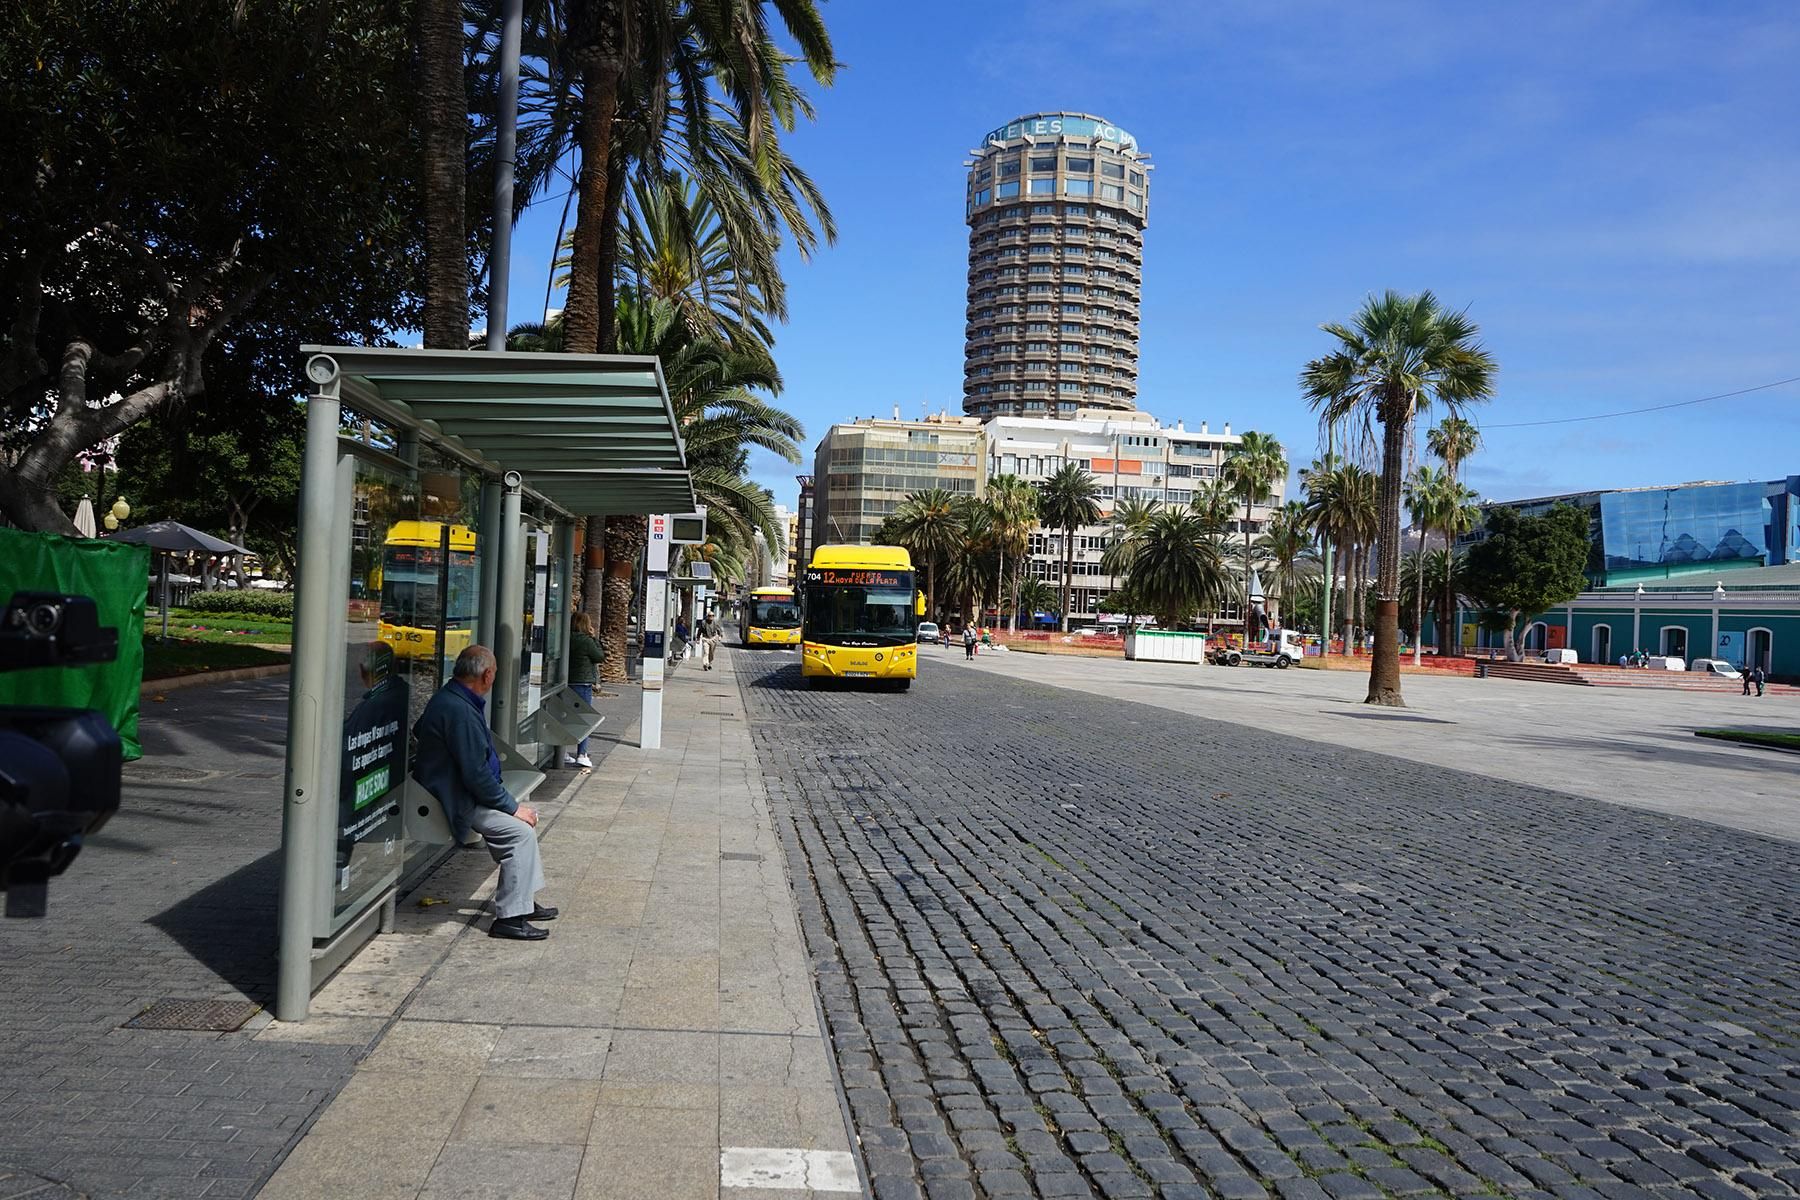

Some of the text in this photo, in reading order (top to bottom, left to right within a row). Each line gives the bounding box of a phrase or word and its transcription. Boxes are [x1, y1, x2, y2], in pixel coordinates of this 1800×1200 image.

[1094, 125, 1115, 140] AC
[807, 573, 821, 581] 704
[823, 571, 835, 584] 12
[1719, 634, 1731, 646] 20
[348, 735, 357, 751] Las
[352, 755, 361, 771] Las
[356, 777, 373, 804] HAZTE
